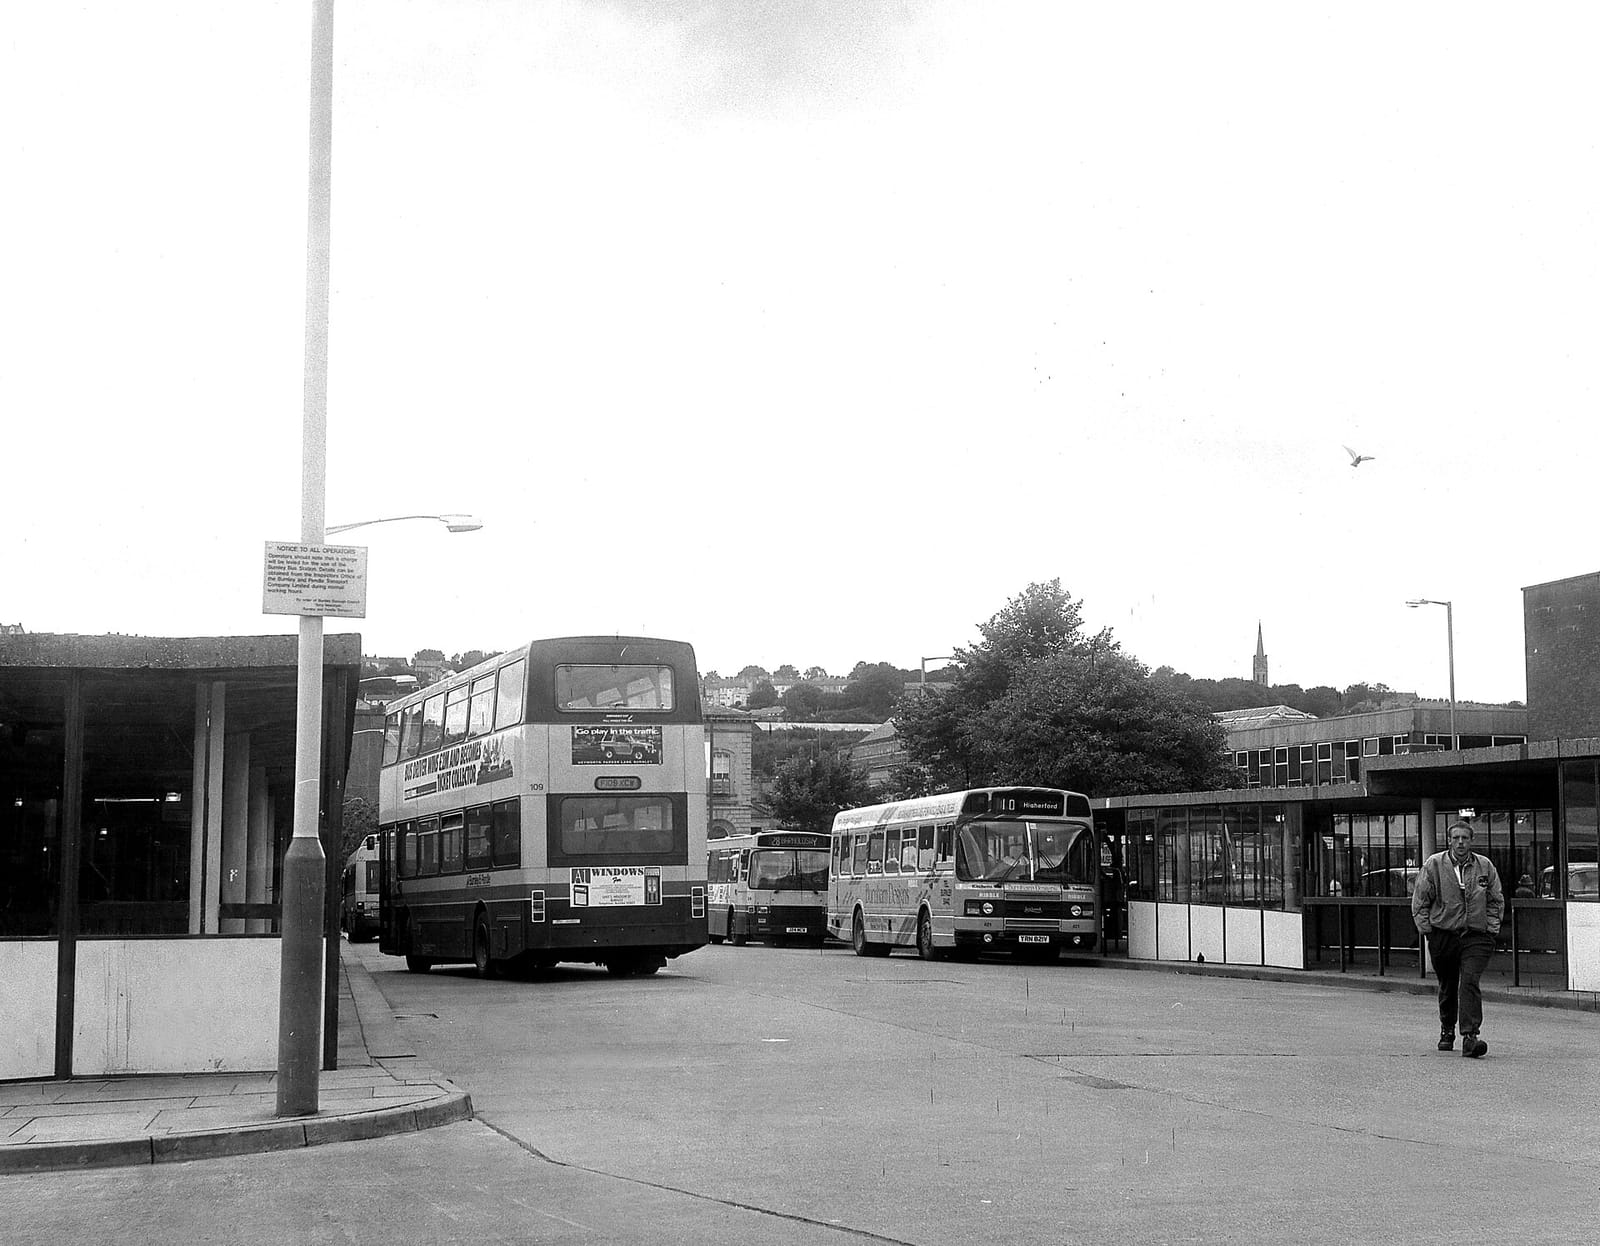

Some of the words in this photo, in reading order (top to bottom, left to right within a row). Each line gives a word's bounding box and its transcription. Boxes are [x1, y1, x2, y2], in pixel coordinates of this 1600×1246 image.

[322, 547, 356, 555] OPERATORS
[591, 728, 608, 737] play
[404, 762, 413, 782] BUS
[413, 757, 427, 780] DRIVER
[427, 753, 439, 776] WINS
[450, 747, 460, 769] AND
[460, 740, 481, 766] BECOMES
[437, 769, 452, 793] TICKET
[452, 763, 477, 790] COLLECTOR
[530, 783, 544, 791] 109
[1002, 798, 1015, 811] 10
[1023, 801, 1058, 810] Higherford
[771, 836, 780, 846] 28
[592, 867, 644, 876] WINDOWS
